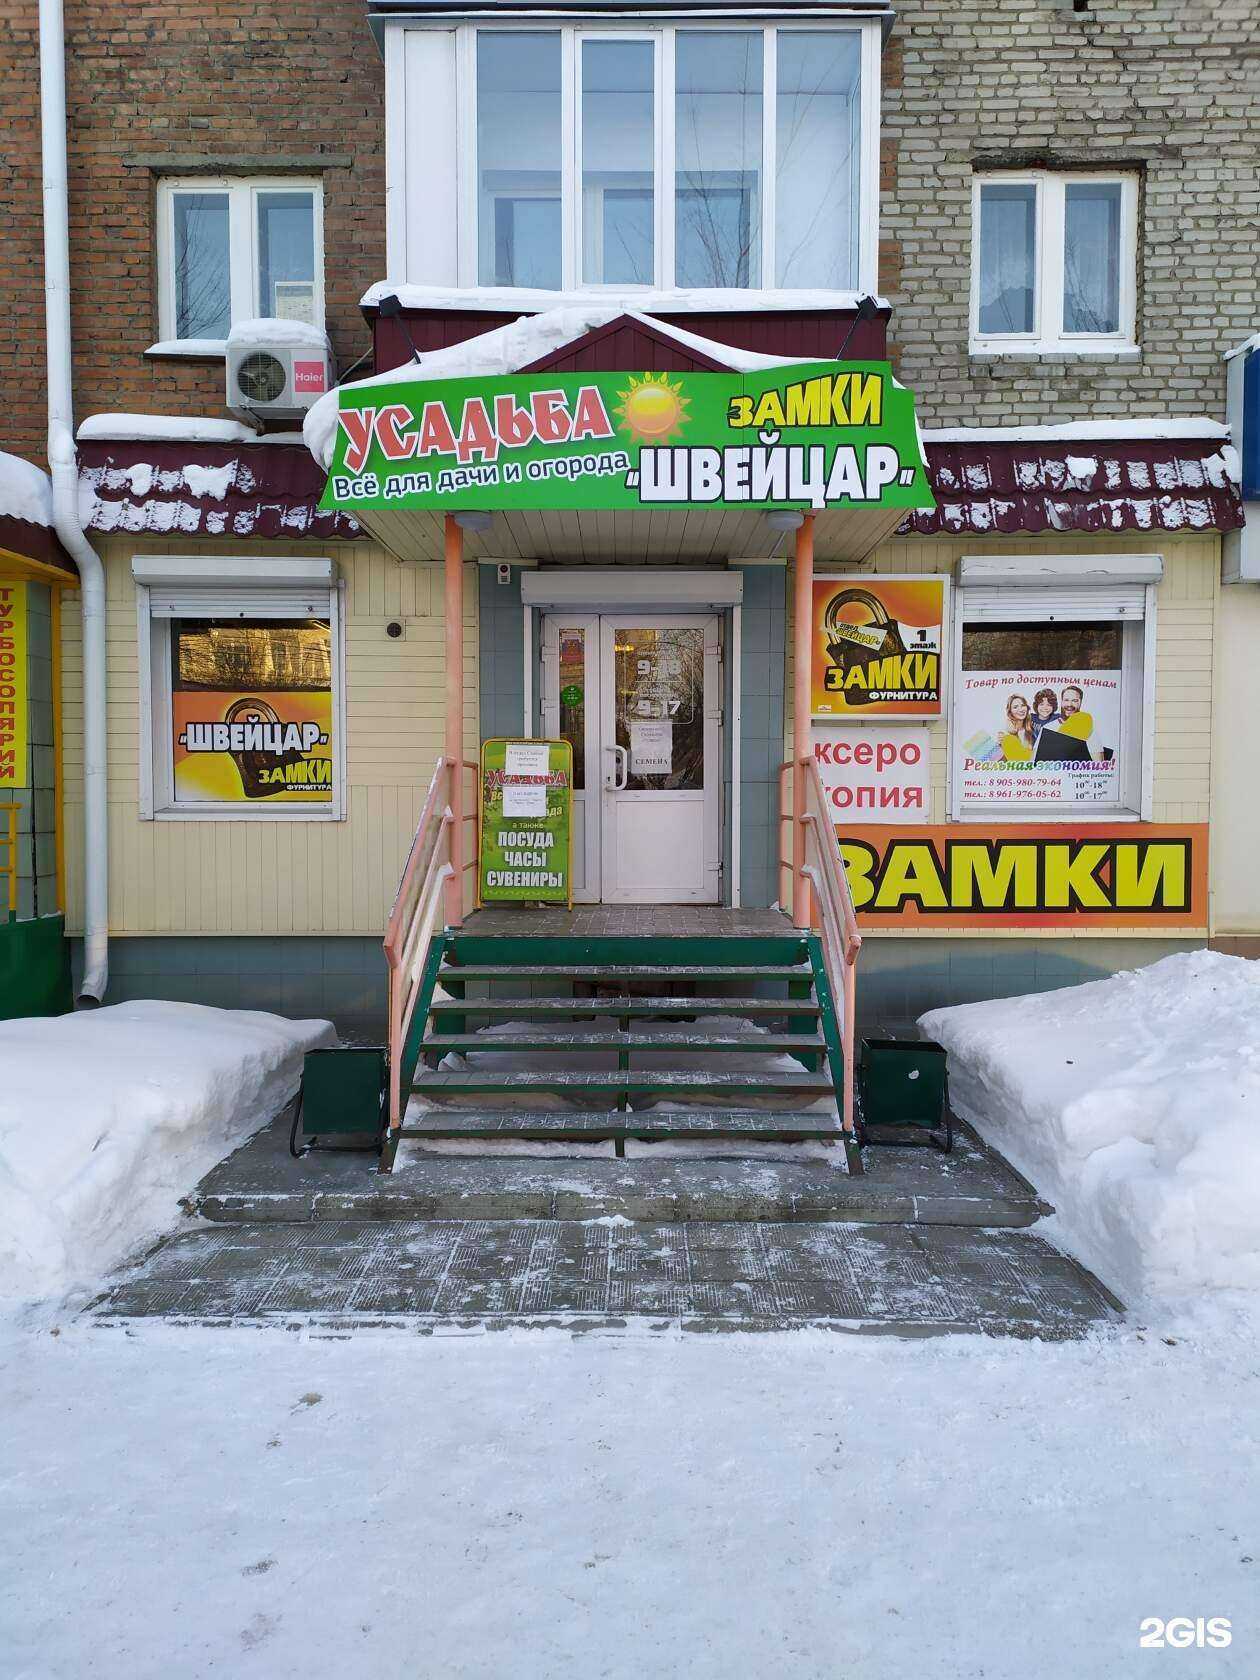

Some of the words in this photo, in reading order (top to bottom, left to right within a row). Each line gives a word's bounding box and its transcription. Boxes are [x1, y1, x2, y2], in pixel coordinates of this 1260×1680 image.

[295, 372, 323, 382] Haier
[727, 371, 883, 429] ЗАМКИ
[338, 385, 615, 474] УСАДЬБА
[334, 475, 378, 500] Всё
[385, 471, 430, 497] для
[437, 465, 499, 493] дачи
[506, 461, 521, 480] и
[527, 452, 629, 485] огорода
[916, 629, 927, 642] 1
[826, 653, 938, 690] ЗАМКИ
[965, 677, 999, 690] Товар
[1001, 677, 1014, 686] по
[1017, 674, 1081, 687] доступным
[1083, 677, 1117, 689] ценам
[868, 691, 938, 700] ФУРНИТУРА
[815, 742, 922, 772] ксеро
[963, 758, 1033, 771] Реальная
[1036, 758, 1116, 771] экономия!
[258, 760, 332, 784] ЗАМКИ
[964, 779, 987, 787] тел.:
[996, 779, 1062, 787] 905-980-79-64
[824, 787, 923, 808] опия
[964, 790, 987, 798] тел.:
[996, 791, 1062, 799] 961-976-05-62
[498, 831, 555, 849] ПОСУДА
[504, 851, 547, 867] ЧАСЫ
[486, 871, 563, 888] СУВЕНИРЫ
[838, 838, 1193, 914] ЗАМКИ
